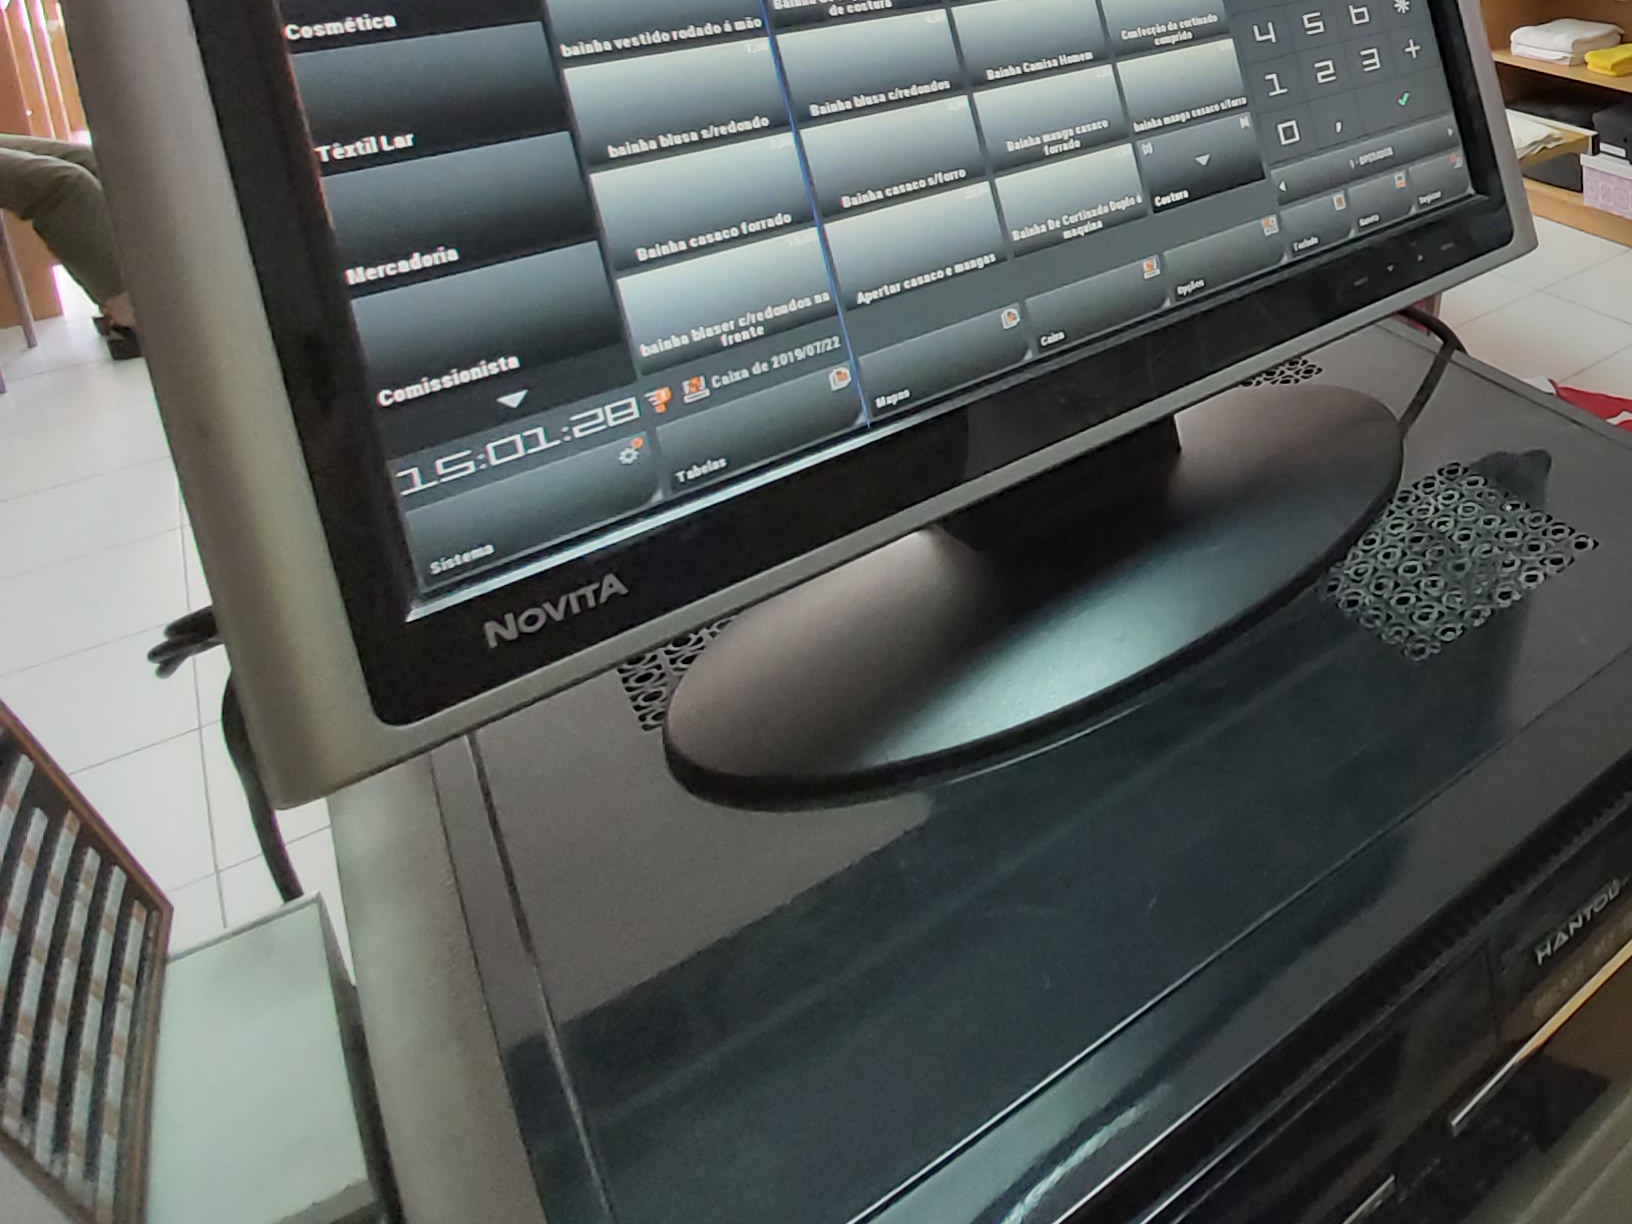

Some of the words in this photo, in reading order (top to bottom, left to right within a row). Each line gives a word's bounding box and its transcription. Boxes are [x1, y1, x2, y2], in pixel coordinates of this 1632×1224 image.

[284, 13, 398, 41] Cosmética
[829, 4, 846, 18] de
[1252, 21, 1278, 44] 4
[1301, 10, 1326, 36] 5
[1347, 4, 1371, 26] 6
[560, 40, 613, 58] bainha
[613, 29, 671, 50] vestido
[671, 23, 722, 41] rodado
[734, 16, 763, 32] mão
[985, 63, 1022, 81] Bainha
[1022, 57, 1059, 74] Camisa
[1058, 50, 1095, 67] Homem
[1264, 72, 1289, 98] 1
[1313, 58, 1337, 85] 2
[1359, 47, 1382, 73] 3
[809, 99, 854, 118] Bainha
[853, 92, 888, 109] blusa
[379, 130, 416, 152] Lar
[607, 137, 658, 159] bainha
[657, 129, 699, 149] blusa
[1005, 134, 1042, 153] Bainha
[1042, 127, 1076, 146] manga
[1075, 118, 1109, 136] casaco
[1276, 118, 1302, 146] 0
[841, 189, 884, 209] Bainha
[884, 178, 927, 198] casaco
[635, 237, 687, 263] Bainha
[686, 227, 740, 249] casaco
[740, 212, 793, 236] forrado
[1011, 223, 1047, 243] Bainha
[344, 246, 460, 287] Mercadoria
[856, 281, 902, 306] Apertar
[902, 267, 945, 291] casaco
[944, 264, 954, 279] e
[953, 252, 998, 275] mangas
[639, 332, 690, 358] bainha
[690, 319, 736, 343] blaser
[813, 290, 831, 306] na
[719, 324, 766, 348] frente
[710, 368, 751, 390] Caixa
[751, 360, 770, 376] de
[770, 334, 842, 371] 2019/07/22
[377, 354, 522, 409] Comissionista
[875, 387, 911, 410] Mapas
[394, 396, 641, 497] 15:01:28
[674, 455, 728, 484] Tabelas
[428, 542, 496, 576] Sistema
[483, 572, 630, 649] NOVITA
